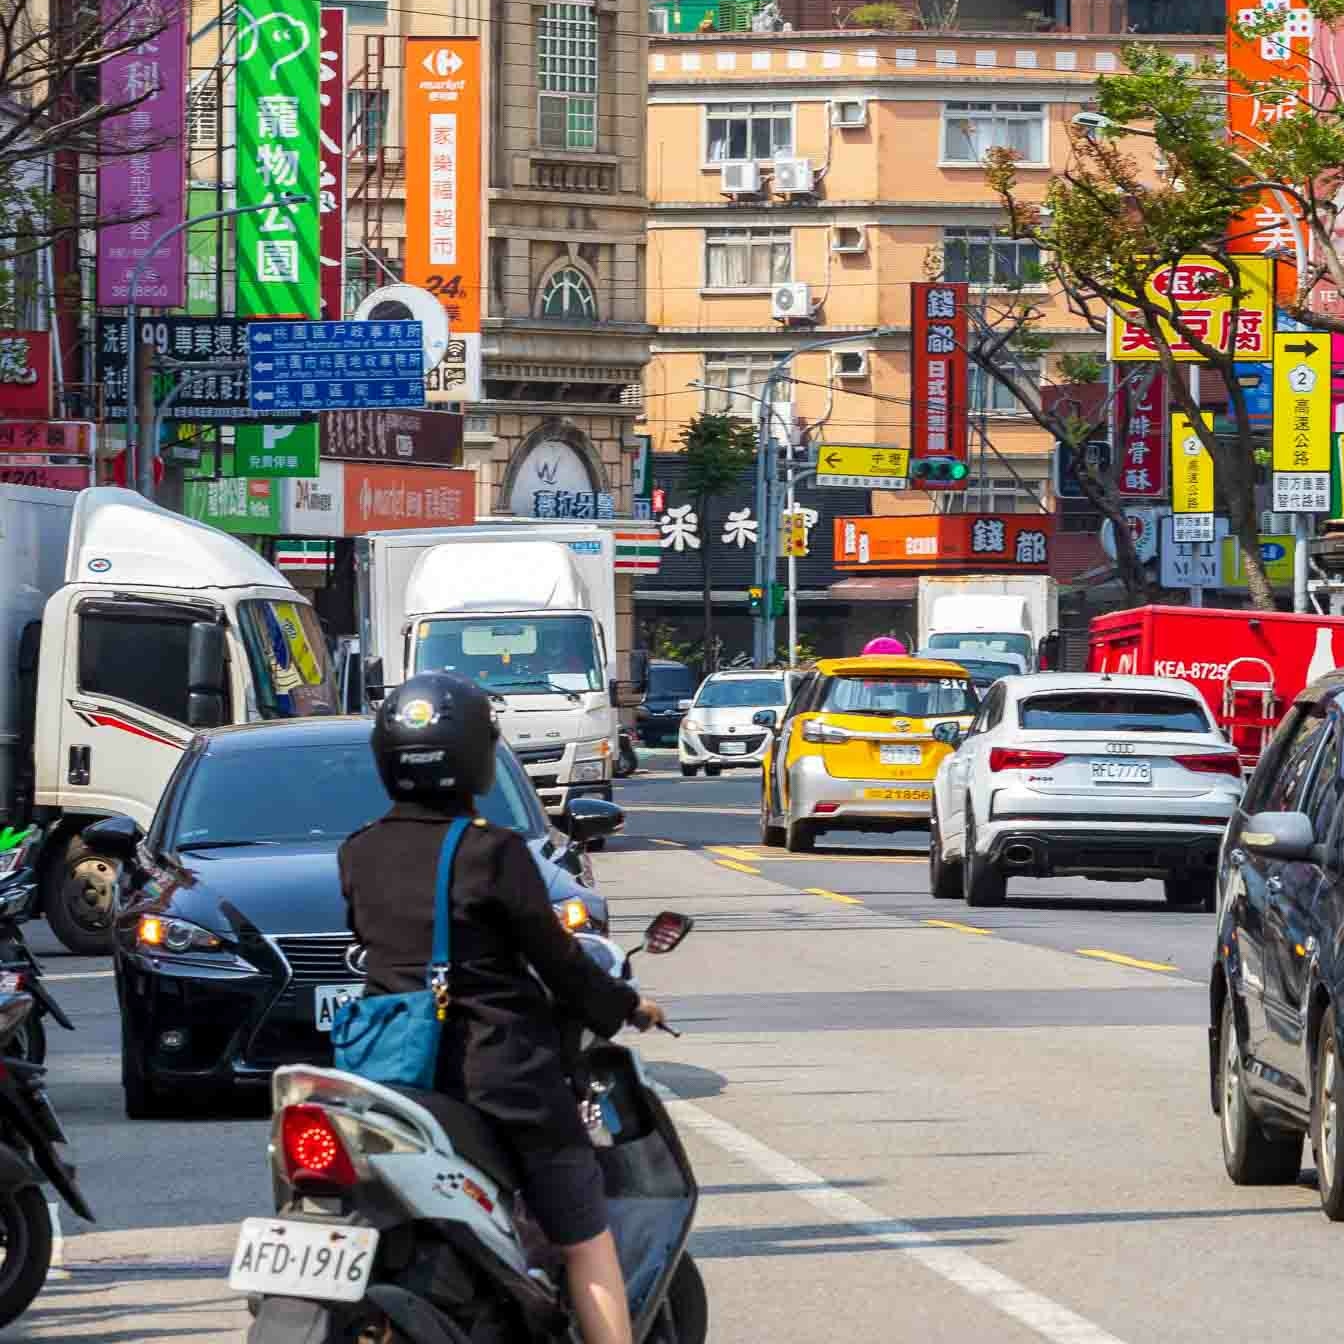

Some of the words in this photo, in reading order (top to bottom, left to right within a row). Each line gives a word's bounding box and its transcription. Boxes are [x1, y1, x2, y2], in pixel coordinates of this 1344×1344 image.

[256, 94, 300, 283] 寵物公園
[1298, 372, 1307, 386] 2
[1292, 399, 1310, 467] 高速公路
[973, 519, 1047, 563] 錢都
[1154, 660, 1228, 680] KEA-8725
[237, 1241, 365, 1284] AFD-1916
